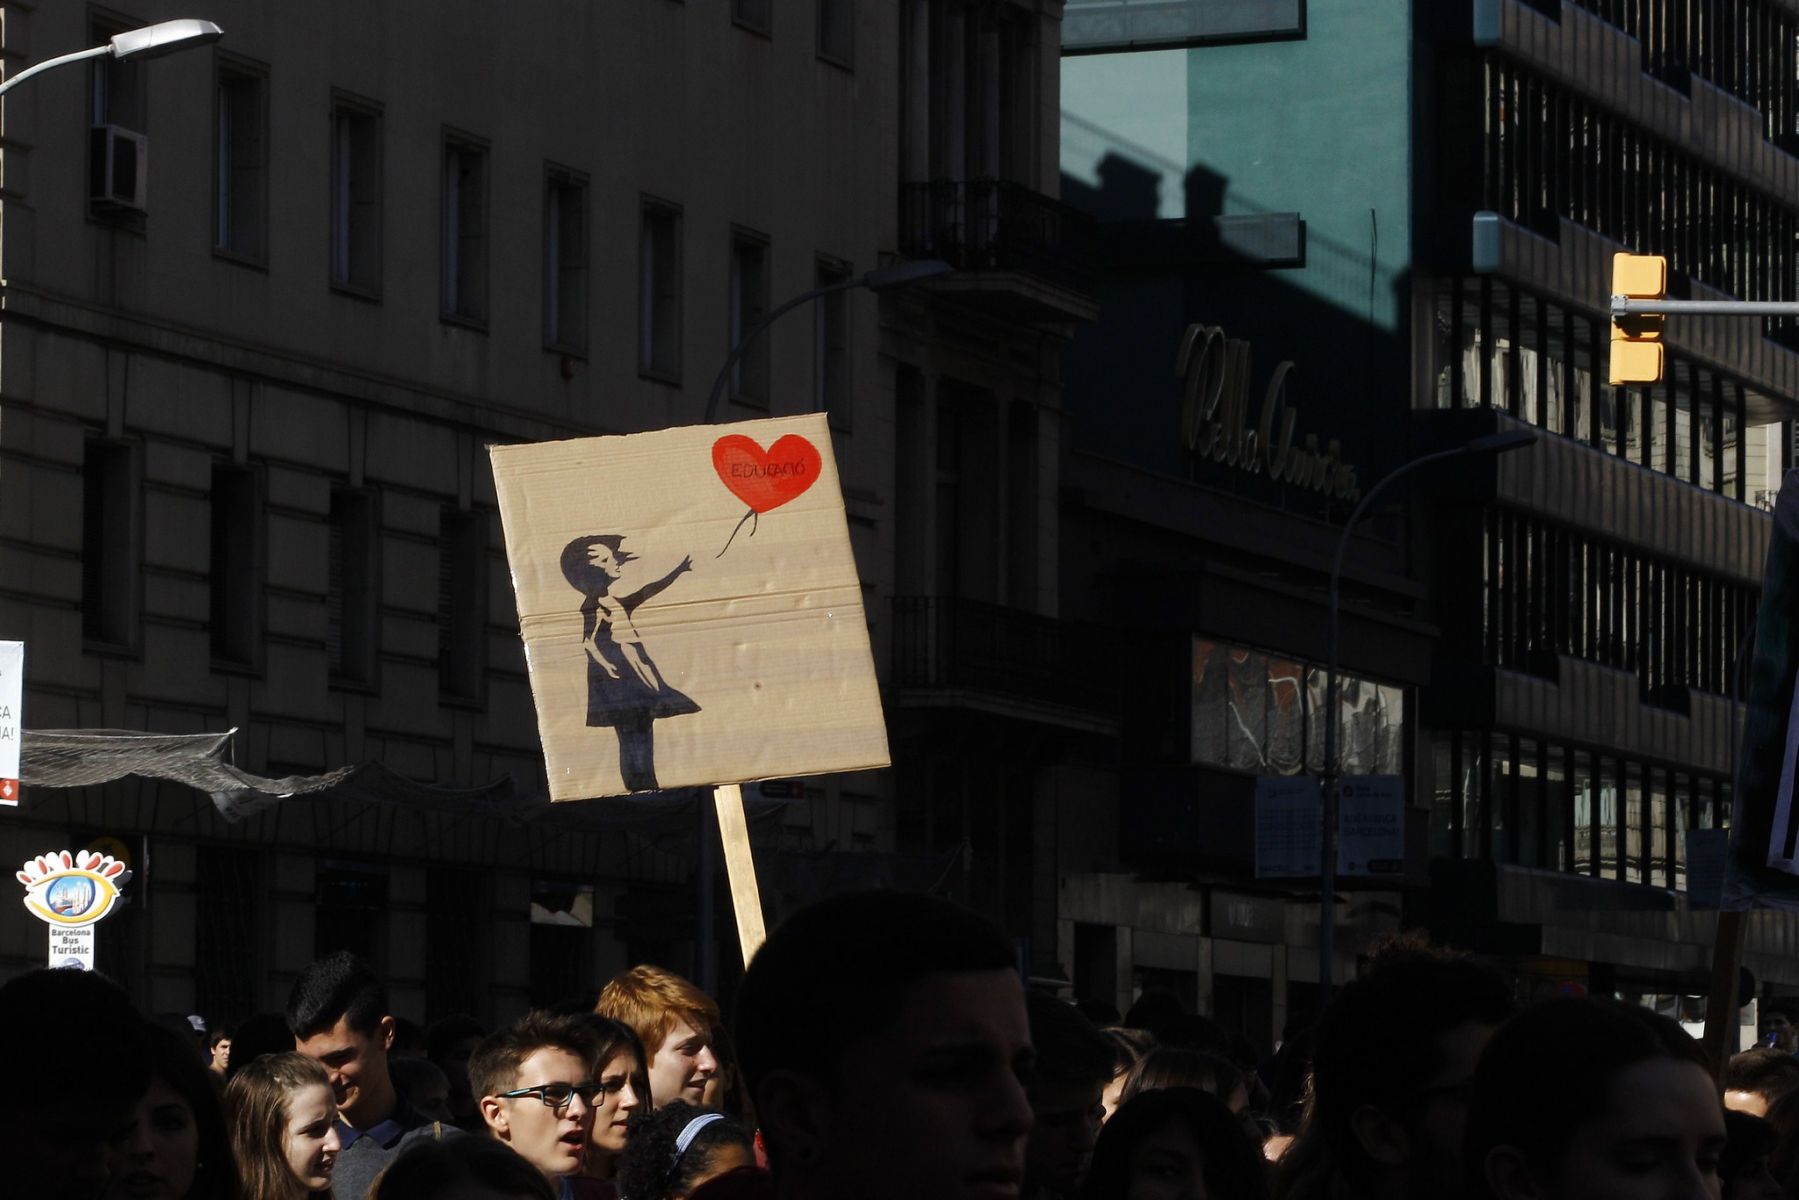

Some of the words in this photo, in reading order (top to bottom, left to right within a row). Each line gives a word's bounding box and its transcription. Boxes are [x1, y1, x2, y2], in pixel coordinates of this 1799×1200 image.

[731, 457, 806, 479] EDUCACIÓ
[51, 928, 91, 936] Barcelona
[62, 936, 79, 944] Bus
